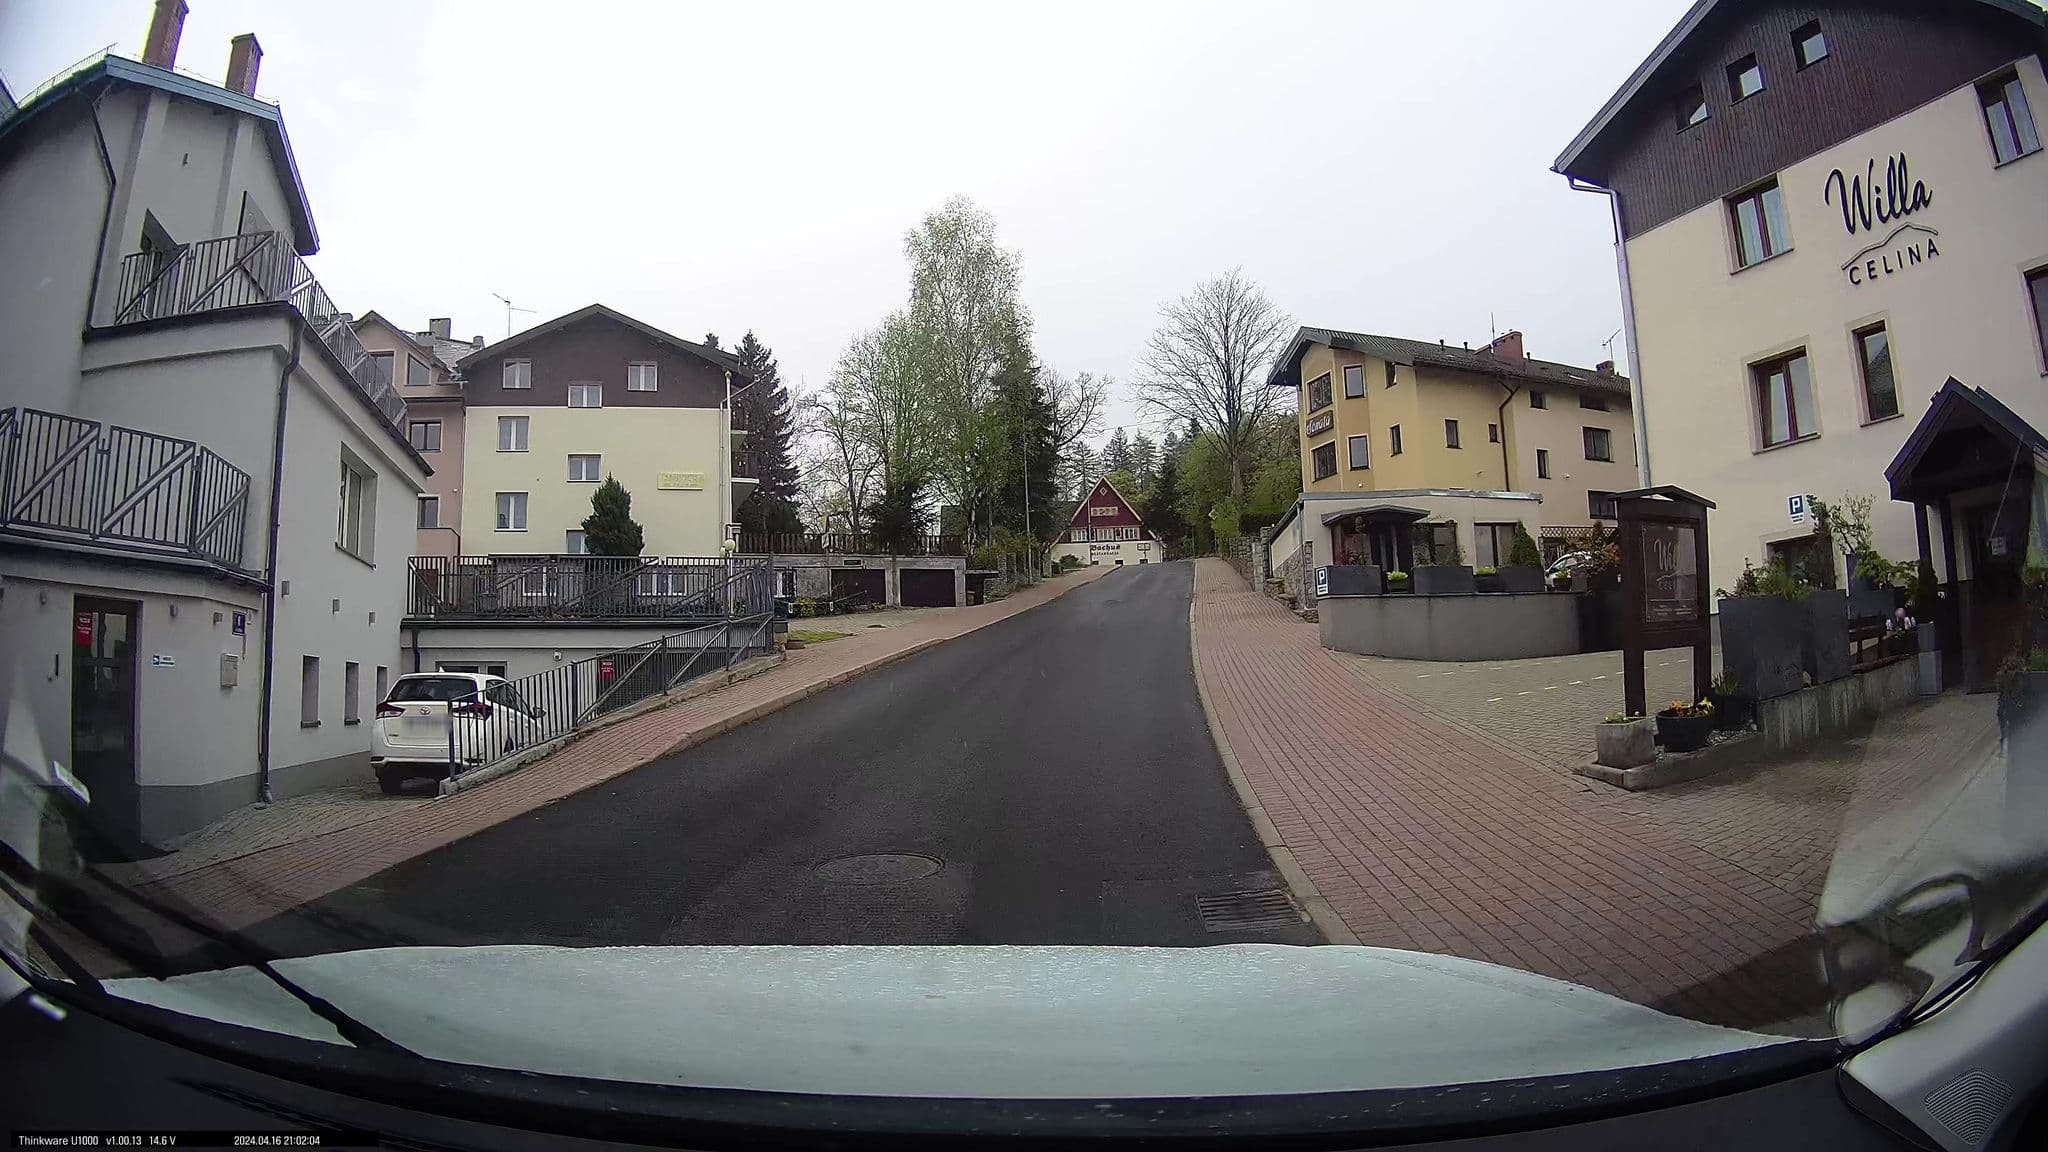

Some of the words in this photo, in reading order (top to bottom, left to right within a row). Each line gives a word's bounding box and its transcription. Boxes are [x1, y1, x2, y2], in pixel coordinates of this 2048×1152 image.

[1823, 151, 1933, 236] Willa
[1848, 237, 1941, 286] CELINA
[1791, 497, 1801, 513] P
[1318, 570, 1326, 584] P
